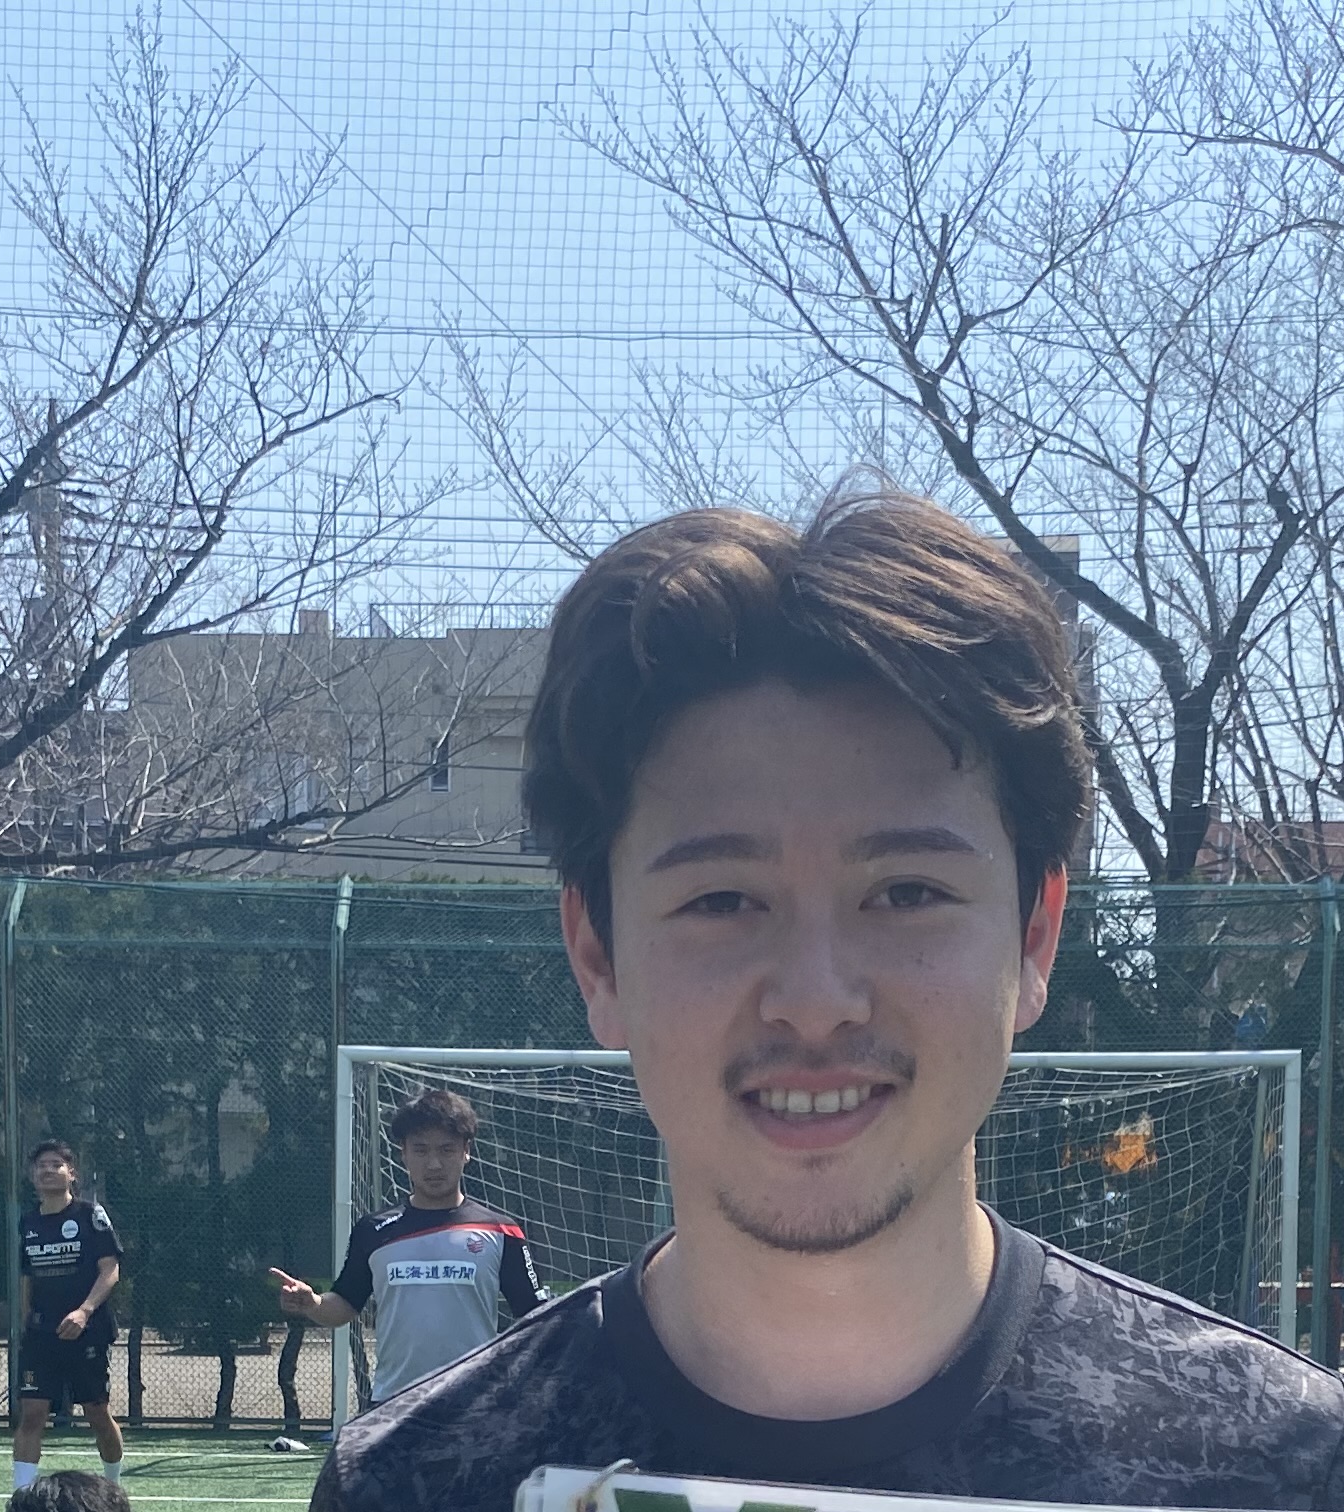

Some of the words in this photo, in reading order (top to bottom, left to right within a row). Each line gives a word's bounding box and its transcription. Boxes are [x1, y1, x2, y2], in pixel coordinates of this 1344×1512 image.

[389, 1265, 475, 1281] 北海道新聞
